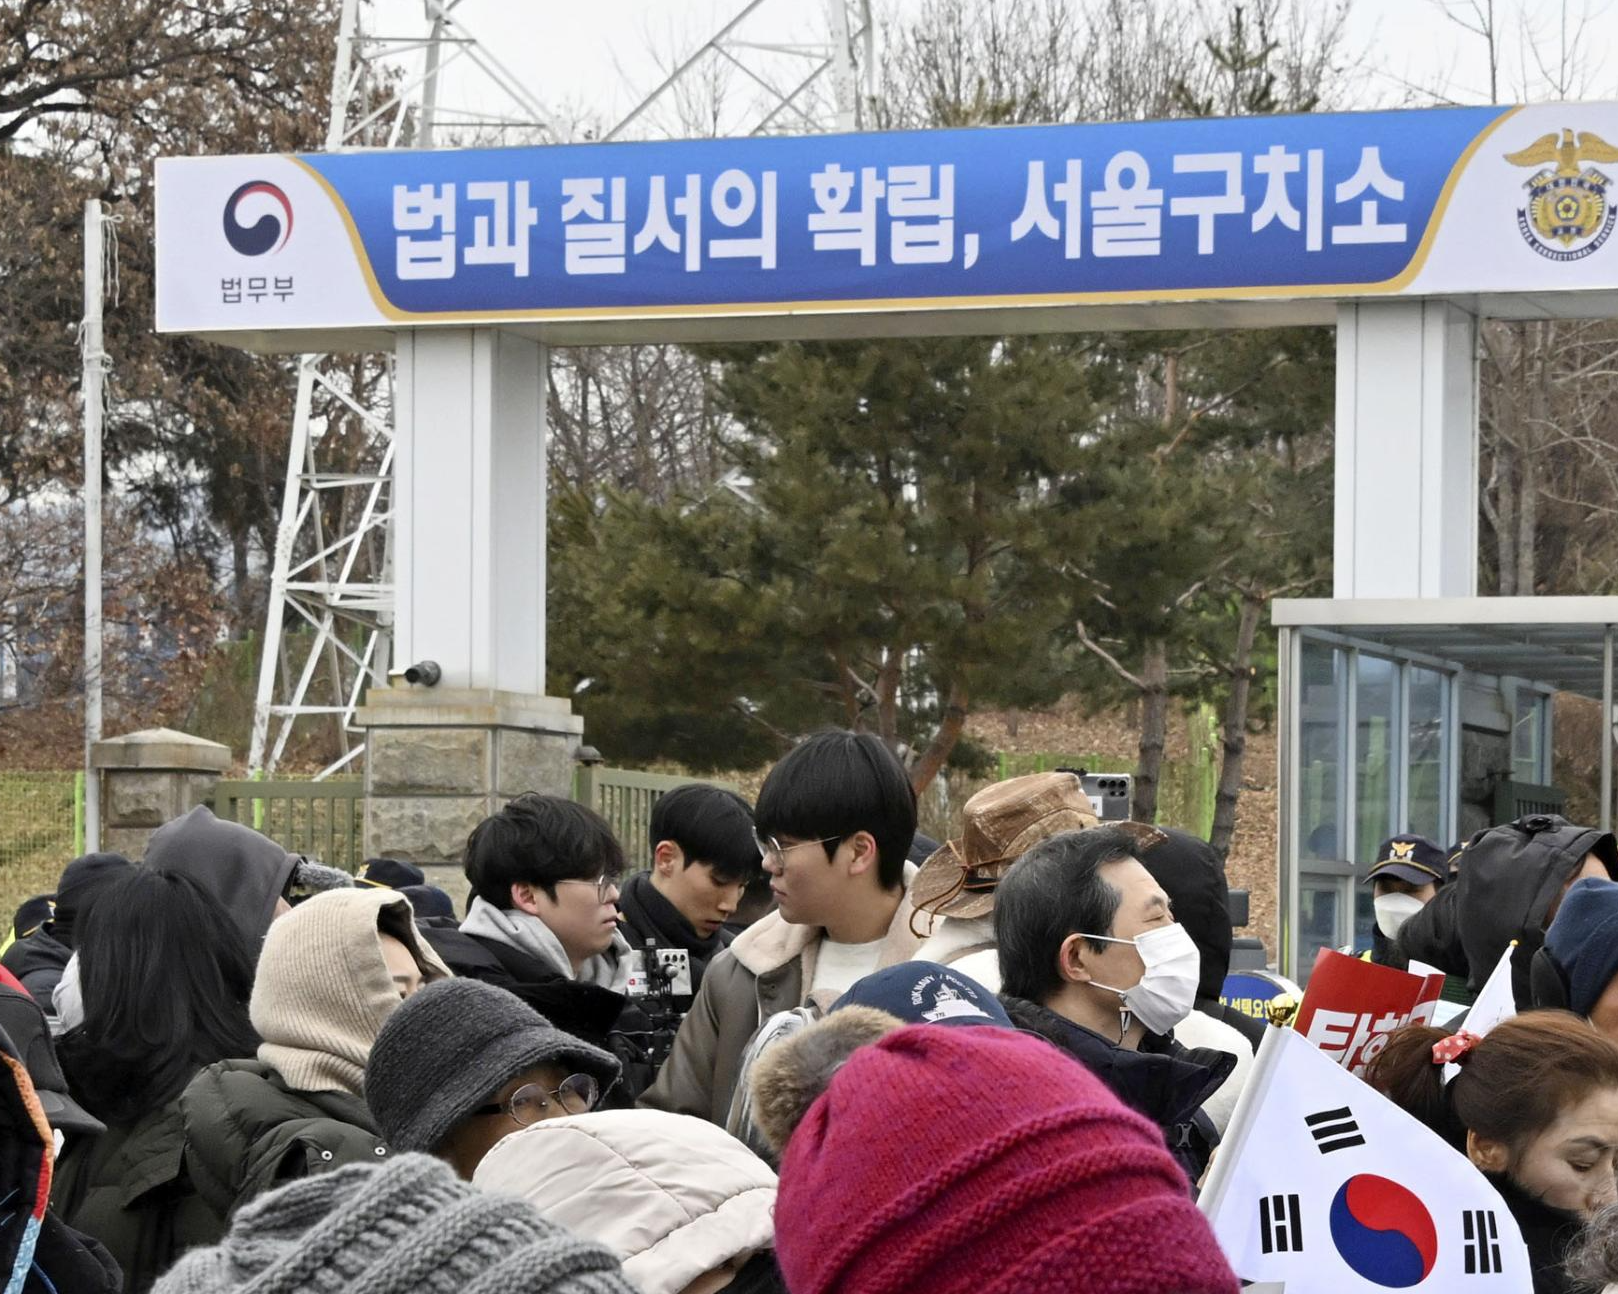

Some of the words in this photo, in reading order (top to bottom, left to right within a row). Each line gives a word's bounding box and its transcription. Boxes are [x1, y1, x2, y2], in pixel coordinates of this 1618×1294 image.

[393, 180, 538, 280] 법과
[561, 169, 777, 275] 질서의
[807, 163, 979, 270] 확립,
[1010, 145, 1407, 260] 서울구치소
[221, 276, 295, 304] 법무부
